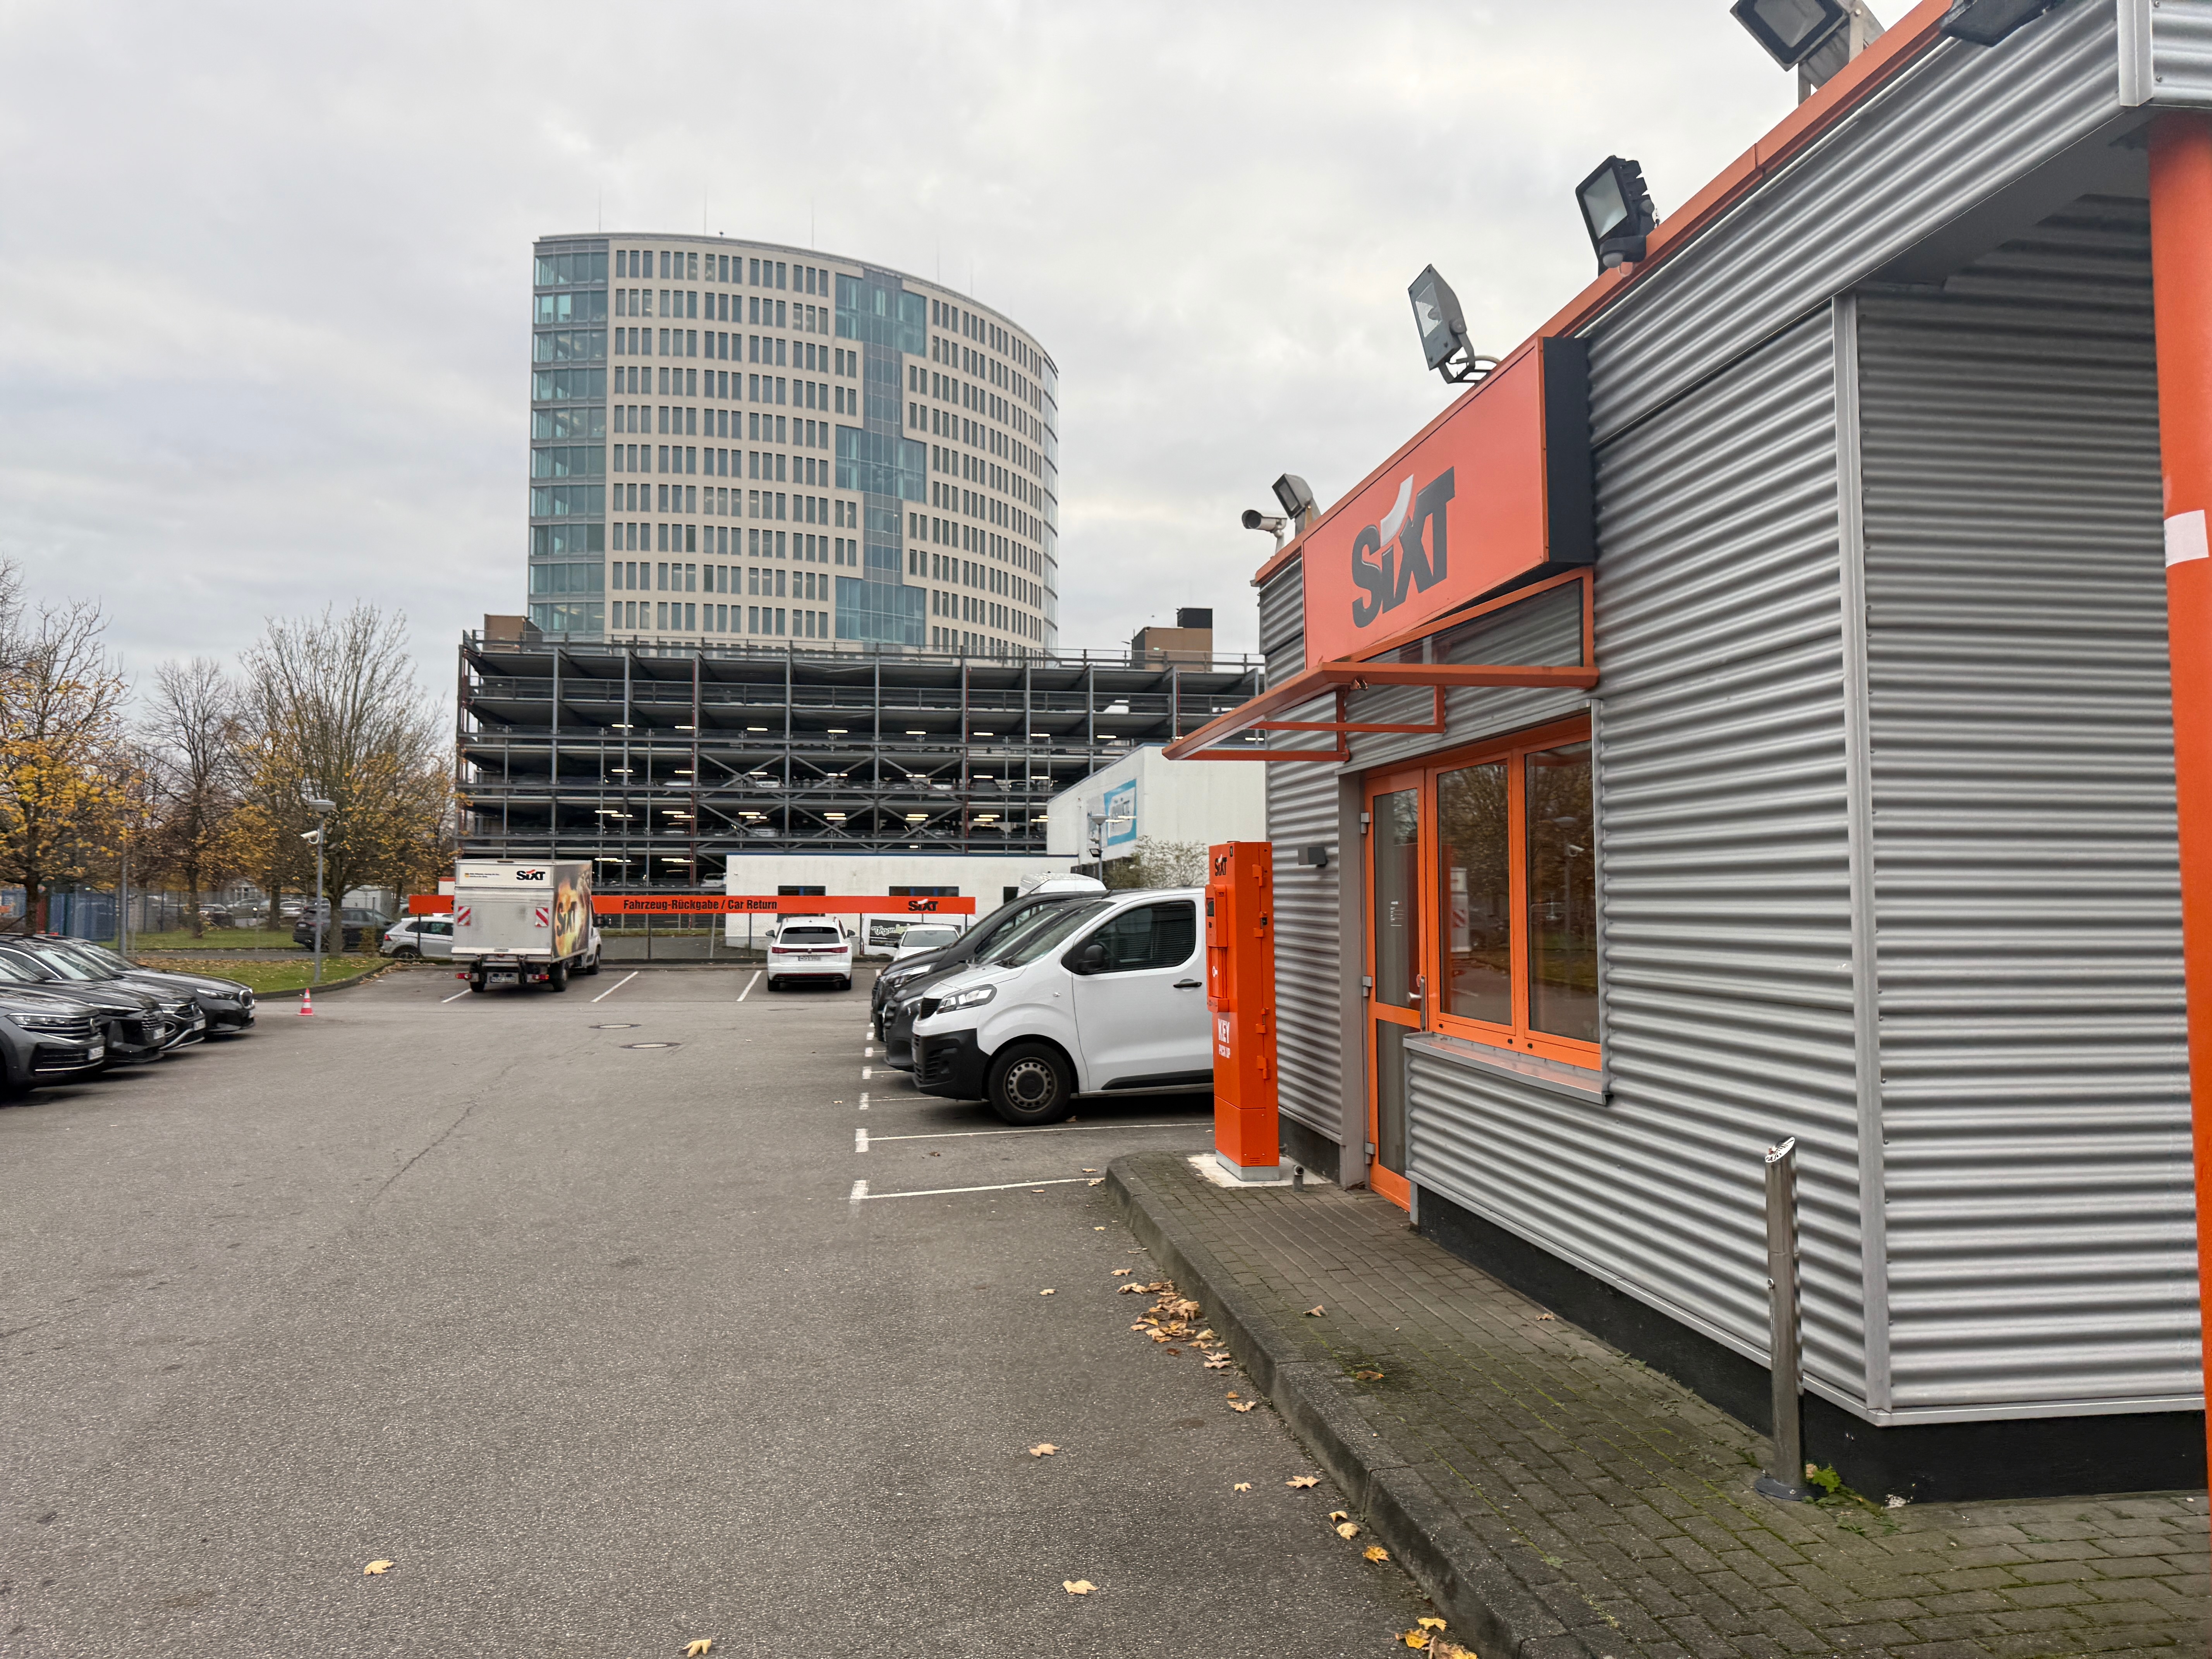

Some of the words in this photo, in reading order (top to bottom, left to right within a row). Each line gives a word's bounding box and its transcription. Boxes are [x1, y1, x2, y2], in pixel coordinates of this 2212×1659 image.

[623, 899, 719, 910] Fahrzeug-Rückgabe
[721, 900, 726, 909] /
[728, 900, 744, 909] Car
[747, 900, 777, 909] Return
[1218, 1018, 1230, 1043] KEY
